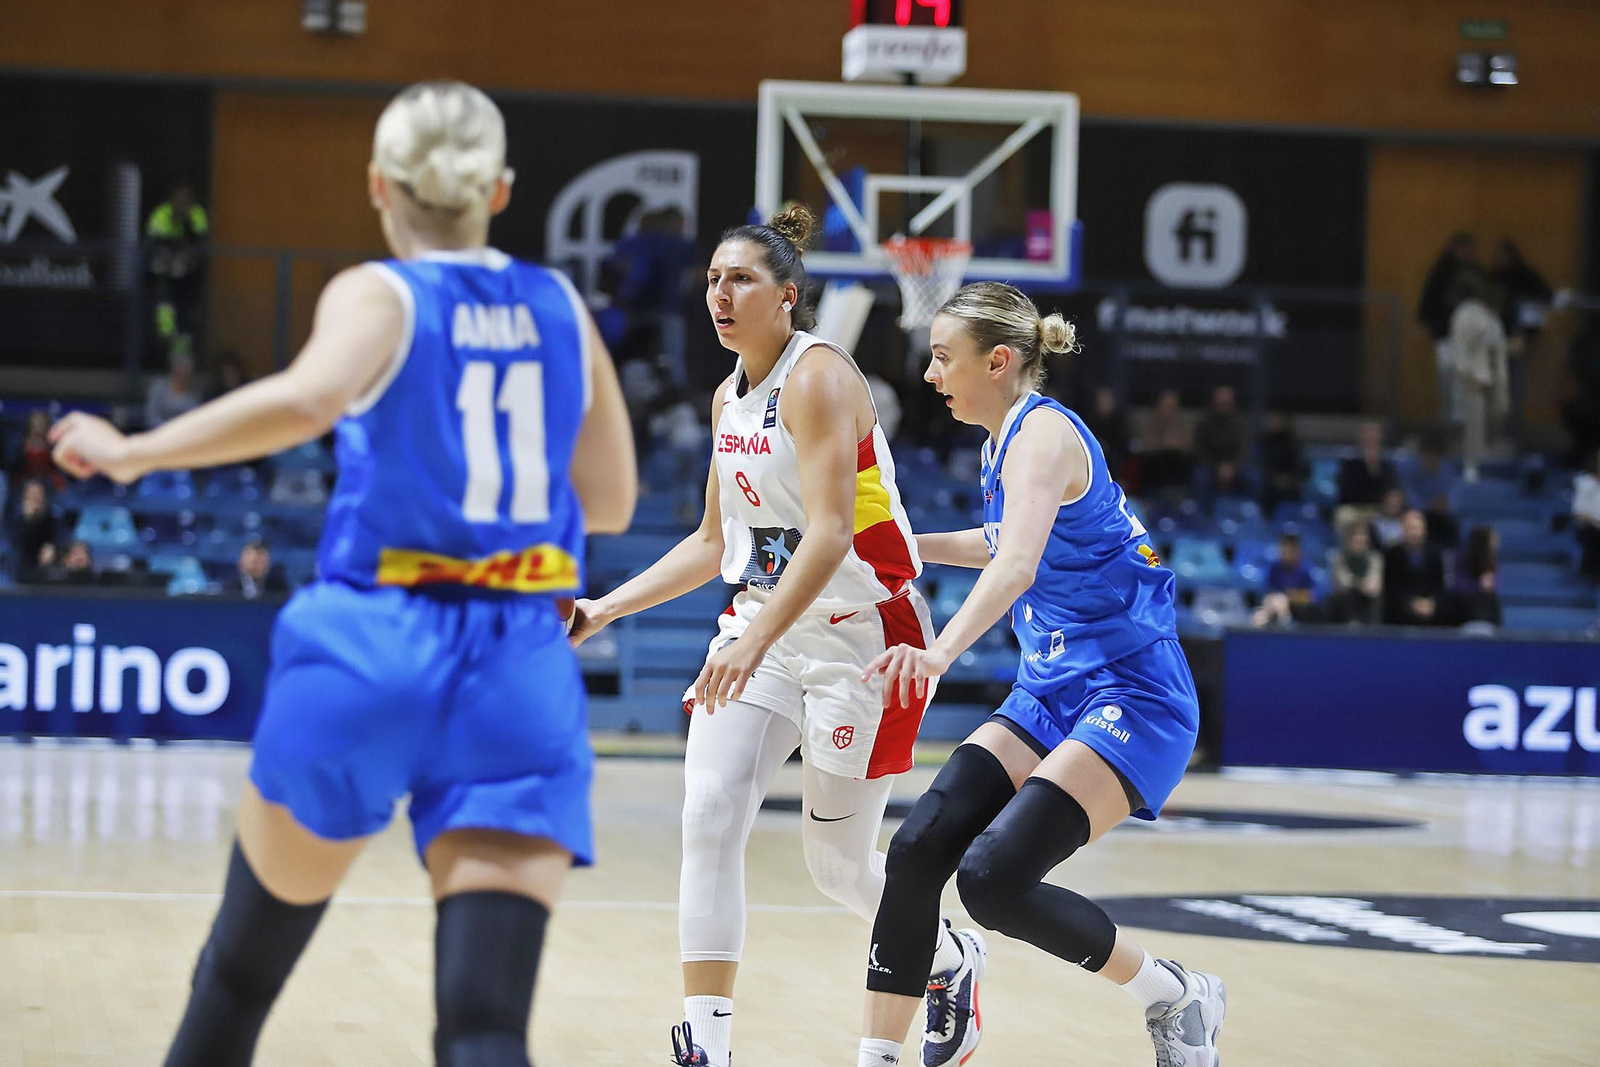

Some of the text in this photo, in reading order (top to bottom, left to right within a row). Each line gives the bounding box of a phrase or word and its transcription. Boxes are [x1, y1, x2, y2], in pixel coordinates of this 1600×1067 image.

[456, 361, 549, 523] 11
[718, 432, 771, 454] ESPAÑA
[735, 471, 761, 507] 8
[1083, 715, 1131, 744] Kristall
